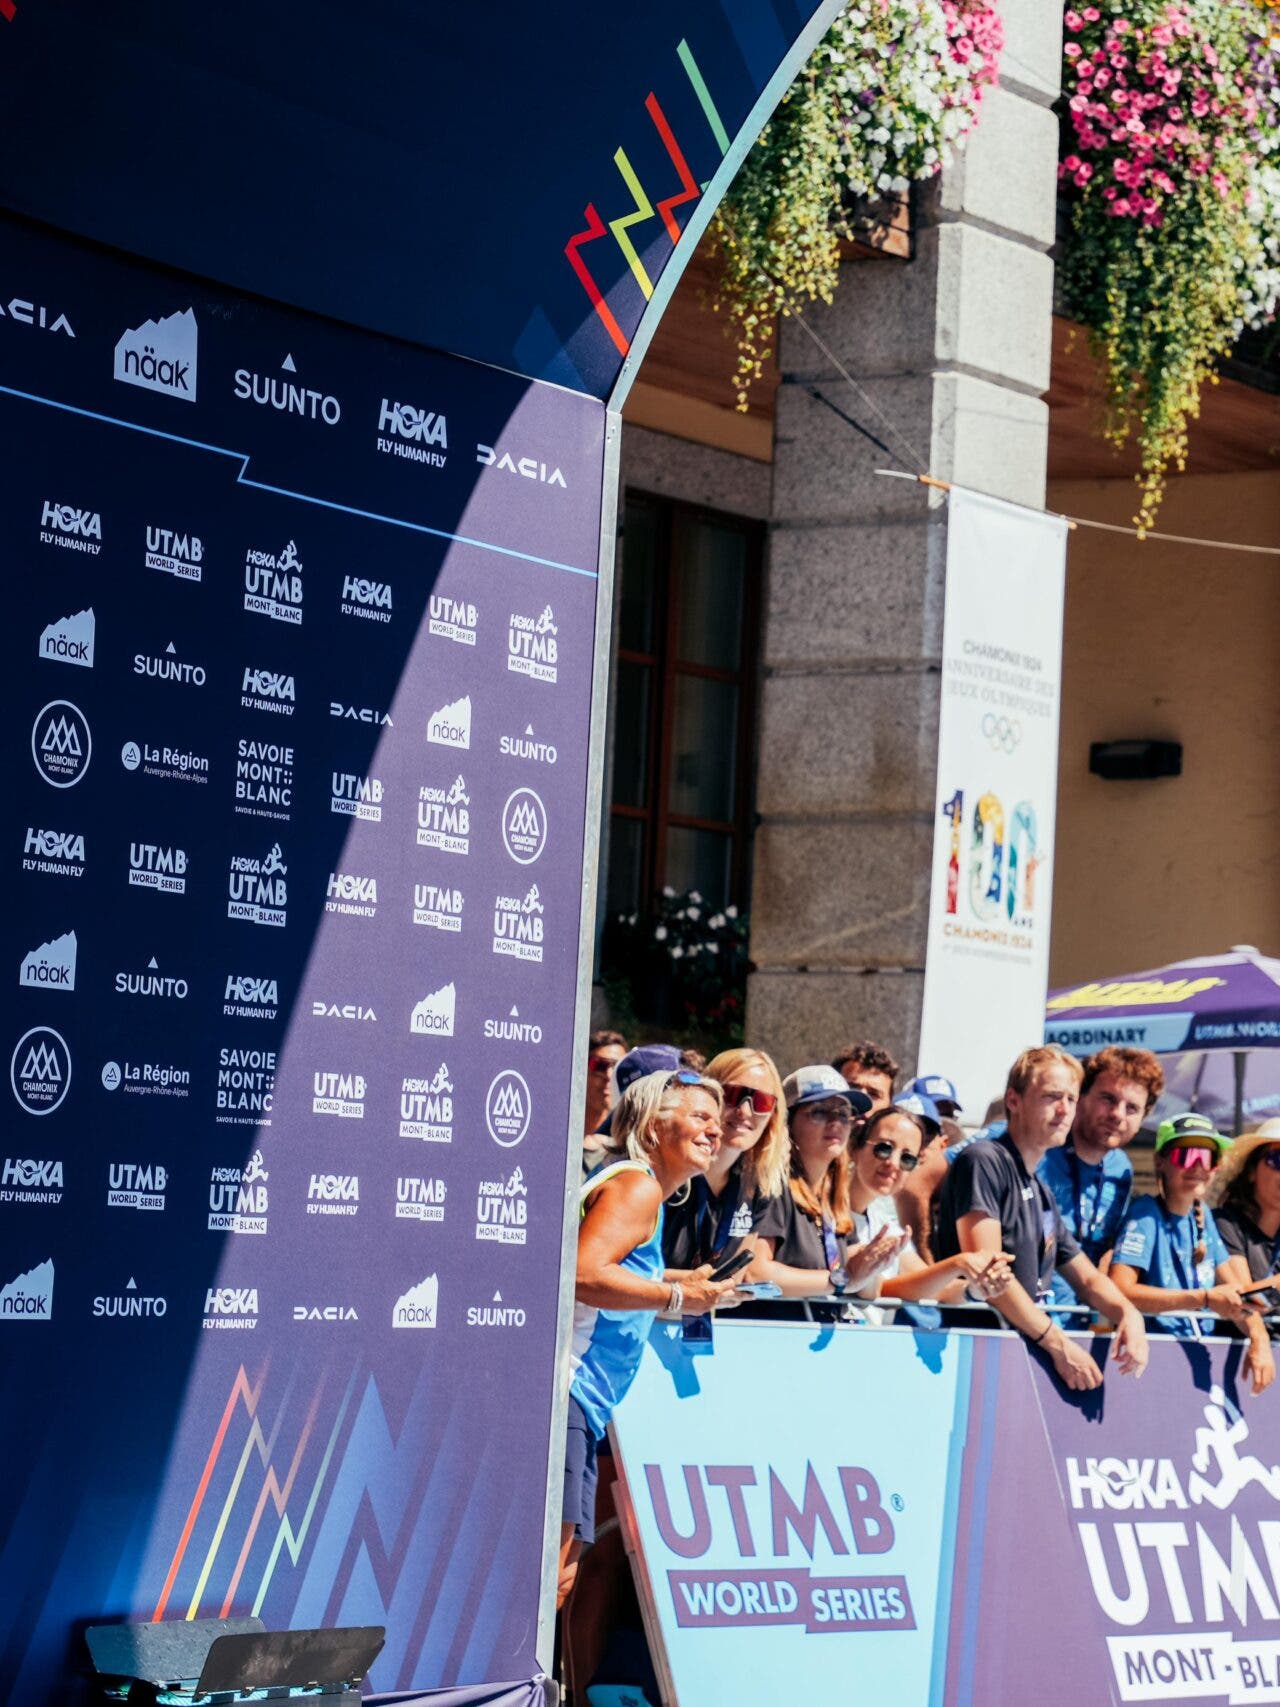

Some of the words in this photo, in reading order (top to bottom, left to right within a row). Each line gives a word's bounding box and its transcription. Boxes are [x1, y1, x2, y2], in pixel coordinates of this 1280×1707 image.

[123, 338, 190, 392] näak
[233, 365, 341, 428] SUUNTO
[377, 394, 449, 451] HOKA
[376, 436, 393, 455] FLY
[393, 441, 430, 465] HUMAN
[430, 451, 446, 469] FLY
[40, 499, 103, 541] HOKA
[39, 531, 54, 545] FLY
[54, 534, 87, 553] HUMAN
[87, 542, 101, 556] FLY
[145, 523, 203, 565] UTMB
[147, 555, 175, 572] WORLD
[176, 564, 199, 580] SERIES
[245, 547, 276, 570] HOKA
[244, 563, 304, 606] UTMB
[341, 573, 394, 611] HOKA
[340, 602, 353, 615] FLY
[353, 605, 380, 622] HUMAN
[380, 611, 392, 624] FLY
[429, 592, 478, 630] UTMB
[509, 611, 535, 632] HOKA
[45, 630, 89, 661] näak
[507, 626, 558, 665] UTMB
[133, 651, 206, 688] SUUNTO
[241, 665, 297, 702] HOKA
[240, 695, 254, 709] FLY
[253, 698, 283, 714] HUMAN
[282, 703, 295, 717] FLY
[432, 717, 466, 743] näak
[43, 751, 78, 768] CHAMONIX
[143, 743, 160, 762] La
[162, 746, 209, 775] Région
[237, 737, 294, 766] SAVOIE
[499, 734, 557, 765] SUUNTO
[236, 759, 282, 785] MONT
[235, 779, 291, 807] BLANC
[331, 769, 383, 805] UTMB
[418, 785, 445, 804] HOKA
[333, 799, 358, 813] WORLD
[359, 806, 380, 819] SERIES
[417, 800, 470, 836] UTMB
[23, 826, 86, 863] HOKA
[129, 840, 188, 876] UTMB
[22, 858, 37, 872] FLY
[37, 860, 70, 876] HUMAN
[70, 864, 84, 878] FLY
[229, 854, 260, 874] HOKA
[131, 871, 159, 886] WORLD
[160, 878, 184, 892] SERIES
[228, 870, 288, 908] UTMB
[326, 871, 379, 904] HOKA
[414, 882, 463, 915] UTMB
[494, 894, 520, 912] HOKA
[493, 909, 544, 942] UTMB
[26, 958, 70, 985] näak
[114, 971, 188, 1000] SUUNTO
[224, 974, 280, 1006] HOKA
[223, 1004, 236, 1016] FLY
[236, 1005, 266, 1019] HUMAN
[265, 1008, 278, 1020] FLY
[415, 1007, 449, 1030] näak
[483, 1018, 542, 1044] SUUNTO
[219, 1047, 276, 1070] SAVOIE
[22, 1080, 58, 1094] CHAMONIX
[123, 1061, 140, 1079] La
[142, 1062, 190, 1088] Région
[217, 1068, 264, 1091] MONT
[313, 1069, 366, 1100] UTMB
[400, 1076, 428, 1093] HOKA
[216, 1089, 273, 1112] BLANC
[315, 1099, 340, 1111] WORLD
[341, 1103, 362, 1115] SERIES
[399, 1091, 453, 1123] UTMB
[1, 1157, 65, 1188] HOKA
[108, 1161, 167, 1192] UTMB
[210, 1166, 241, 1183] HOKA
[0, 1189, 15, 1202] FLY
[15, 1190, 48, 1203] HUMAN
[48, 1191, 63, 1204] FLY
[110, 1192, 138, 1204] WORLD
[140, 1196, 164, 1208] SERIES
[208, 1182, 269, 1214] UTMB
[307, 1173, 361, 1201] HOKA
[396, 1175, 446, 1203] UTMB
[477, 1180, 504, 1196] HOKA
[476, 1195, 527, 1224] UTMB
[2, 1291, 47, 1314] näak
[92, 1295, 167, 1318] SUUNTO
[203, 1287, 260, 1314] HOKA
[397, 1302, 432, 1323] näak
[466, 1306, 526, 1327] SUUNTO
[1066, 1456, 1190, 1511] HOKA
[679, 1579, 799, 1616] WORLD
[813, 1585, 906, 1623] SERIES
